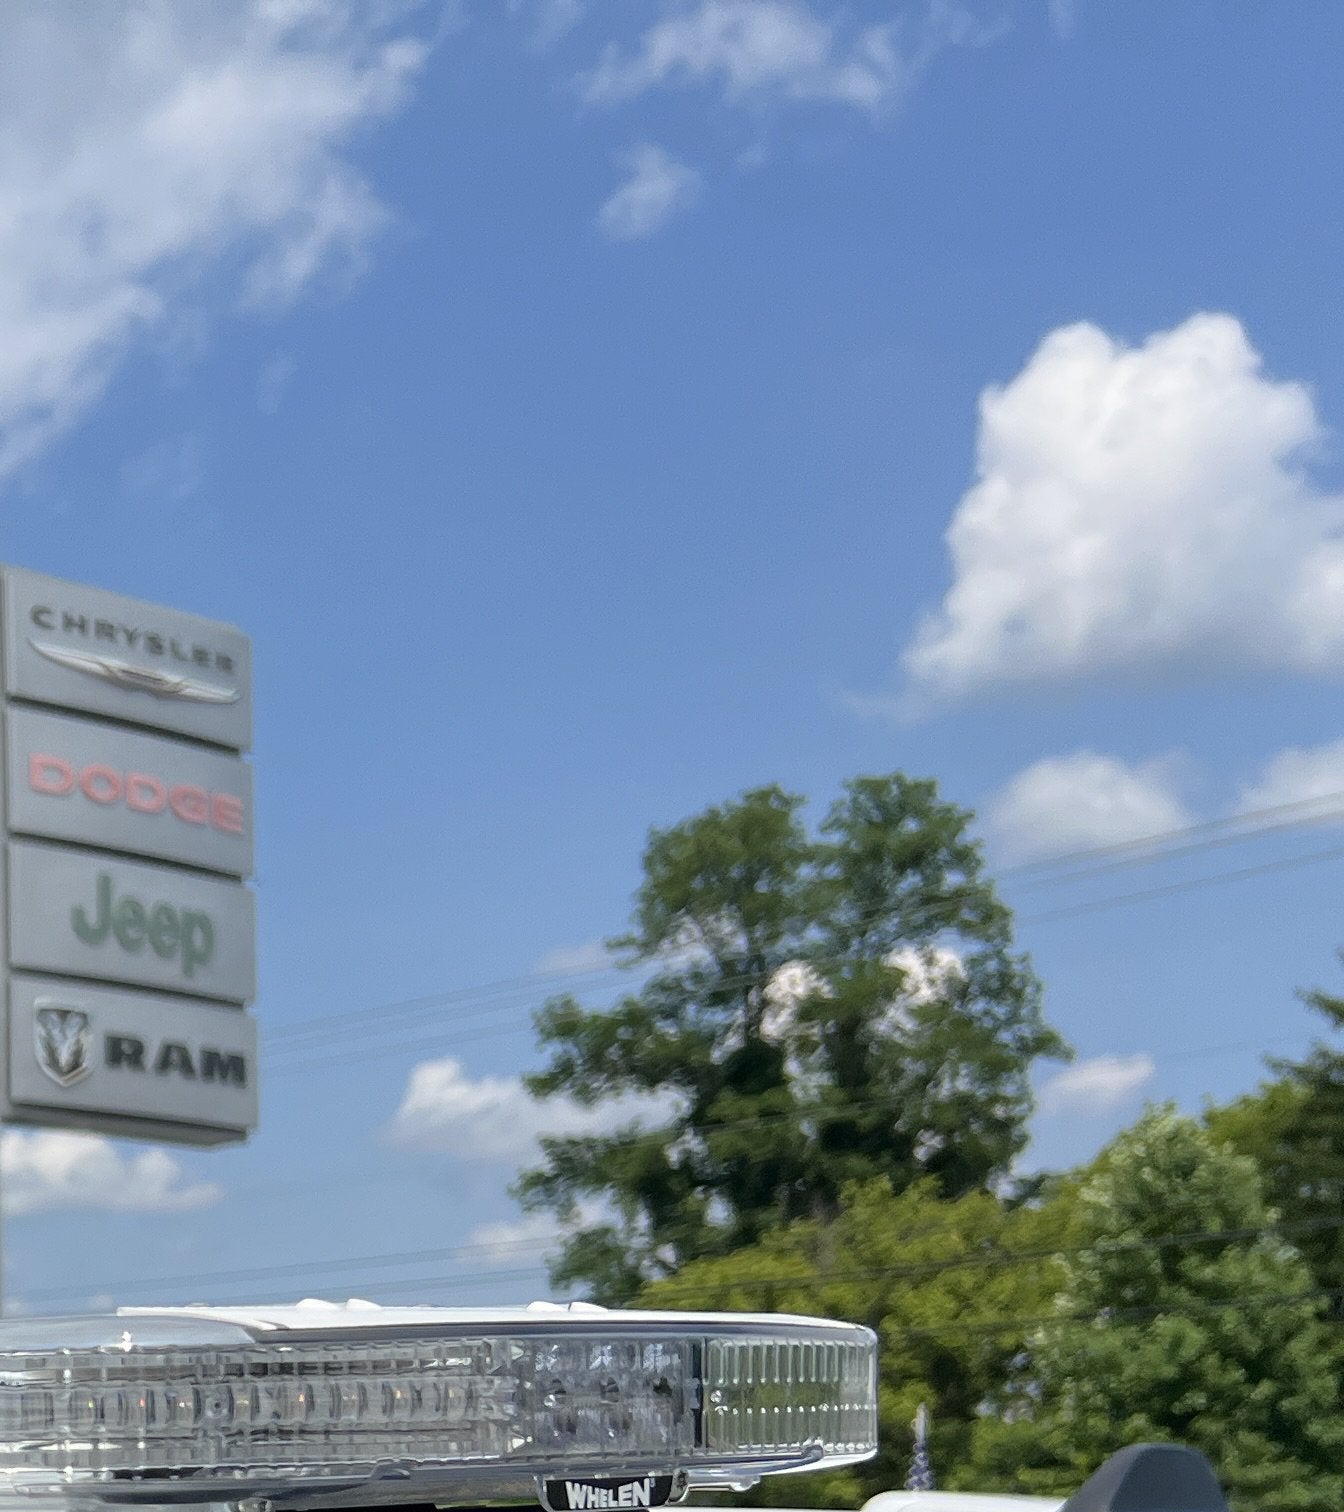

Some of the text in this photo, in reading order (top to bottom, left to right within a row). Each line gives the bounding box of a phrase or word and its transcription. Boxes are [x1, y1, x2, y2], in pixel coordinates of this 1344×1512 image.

[29, 604, 234, 674] CHRYSLER
[28, 753, 244, 833] DODGE
[71, 870, 215, 978] Jeep
[105, 1035, 246, 1088] RAM
[565, 1478, 652, 1509] WHELEN
